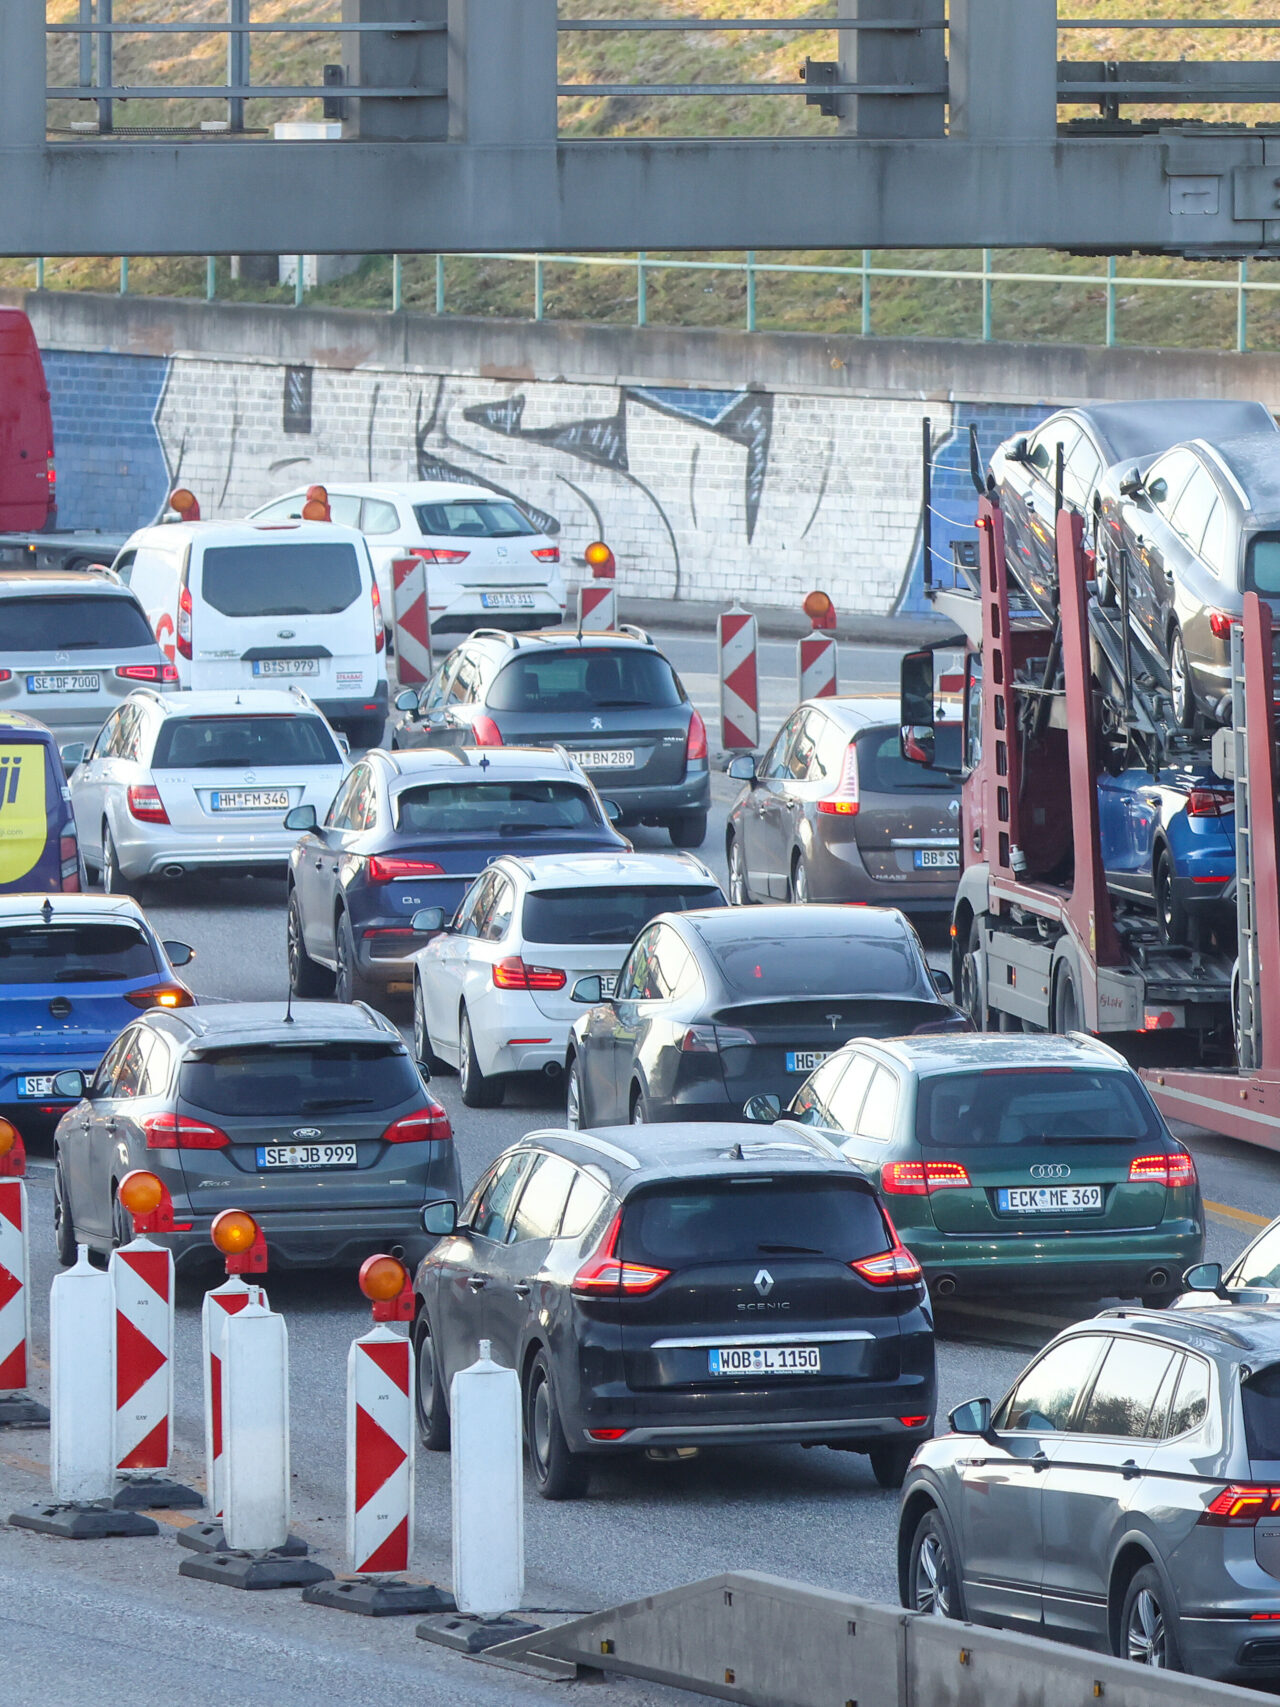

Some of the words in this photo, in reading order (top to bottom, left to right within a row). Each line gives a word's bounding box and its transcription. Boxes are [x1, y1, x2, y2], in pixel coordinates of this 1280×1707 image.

[263, 661, 271, 672] B
[293, 660, 314, 671] 979
[35, 677, 48, 689] SE
[56, 676, 69, 688] DF
[71, 676, 97, 688] 7000
[593, 752, 609, 765] BN
[611, 751, 633, 765] 289
[219, 794, 236, 806] HH
[244, 793, 261, 805] FM
[264, 793, 287, 804] 346
[923, 852, 938, 865] BB
[796, 1054, 814, 1069] HG
[27, 1079, 45, 1093] SE
[267, 1149, 288, 1164] SE
[300, 1148, 320, 1163] JB
[325, 1146, 355, 1162] 999
[1010, 1191, 1038, 1207] ECK
[1049, 1190, 1068, 1206] ME
[1072, 1189, 1099, 1205] 369
[737, 1302, 790, 1310] SCENIC
[720, 1351, 751, 1369] WOB
[764, 1350, 774, 1368] L
[778, 1350, 817, 1367] 1150
